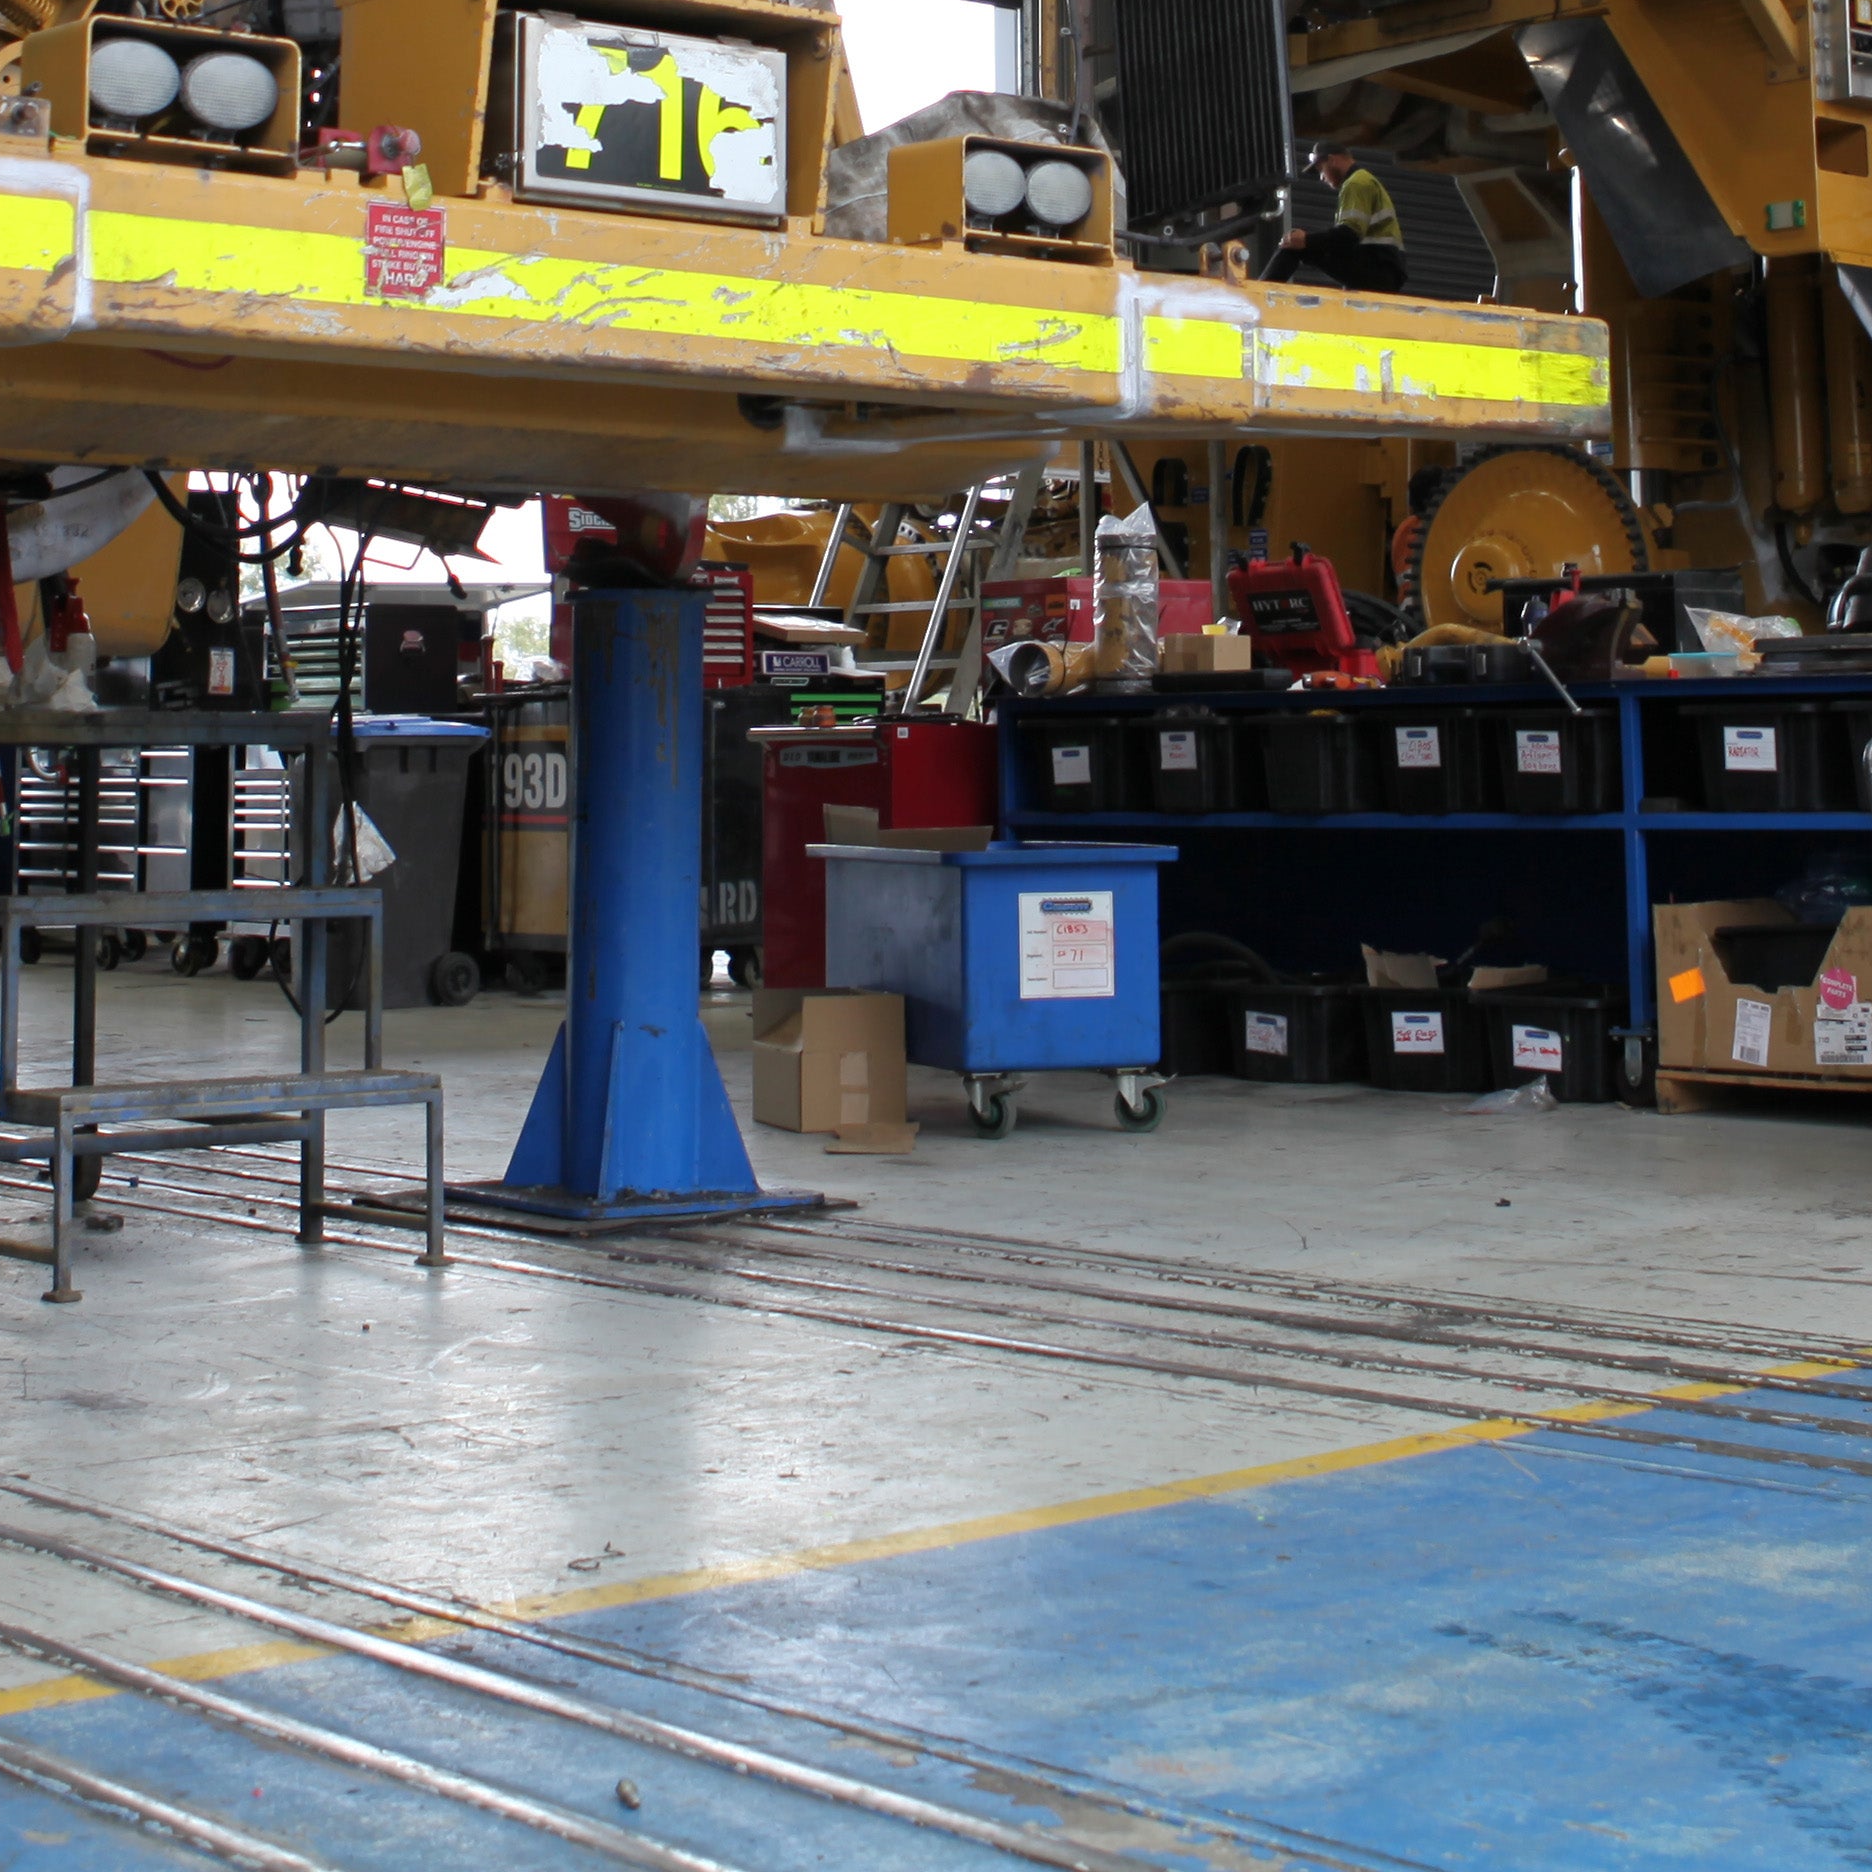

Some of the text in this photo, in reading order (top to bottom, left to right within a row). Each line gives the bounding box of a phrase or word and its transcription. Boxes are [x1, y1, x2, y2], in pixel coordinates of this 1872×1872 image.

[382, 214, 391, 223] IN
[374, 225, 394, 235] FIRE
[782, 655, 821, 669] CARROLL
[492, 752, 568, 809] 93D
[1821, 977, 1854, 993] COMPLETE
[1826, 987, 1847, 999] PARTS
